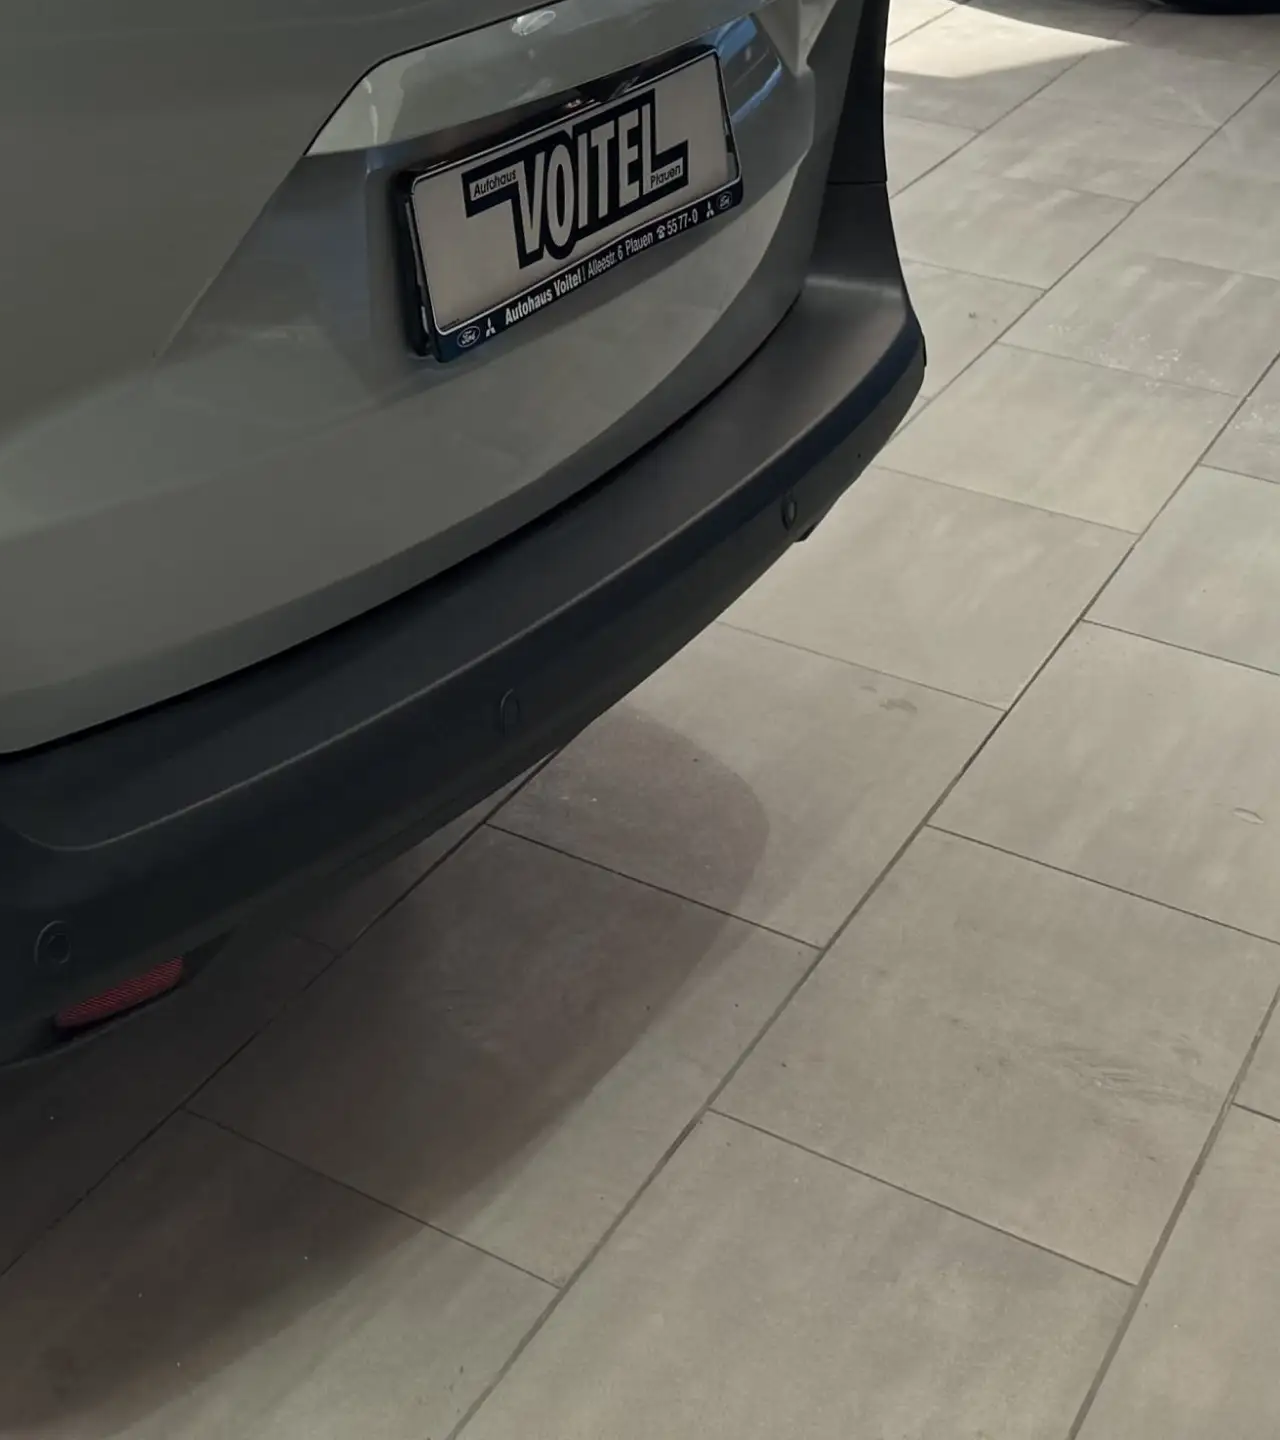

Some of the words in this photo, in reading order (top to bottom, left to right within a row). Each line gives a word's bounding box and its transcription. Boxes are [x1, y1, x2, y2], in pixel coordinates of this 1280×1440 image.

[472, 168, 517, 198] Autohaus
[512, 102, 658, 256] VOITEL
[650, 165, 682, 189] Plauen
[505, 288, 553, 325] Autohaus
[552, 269, 582, 297] Voitel
[587, 248, 617, 280] Alleestr.
[617, 244, 624, 261] 6
[624, 231, 654, 256] Plauen
